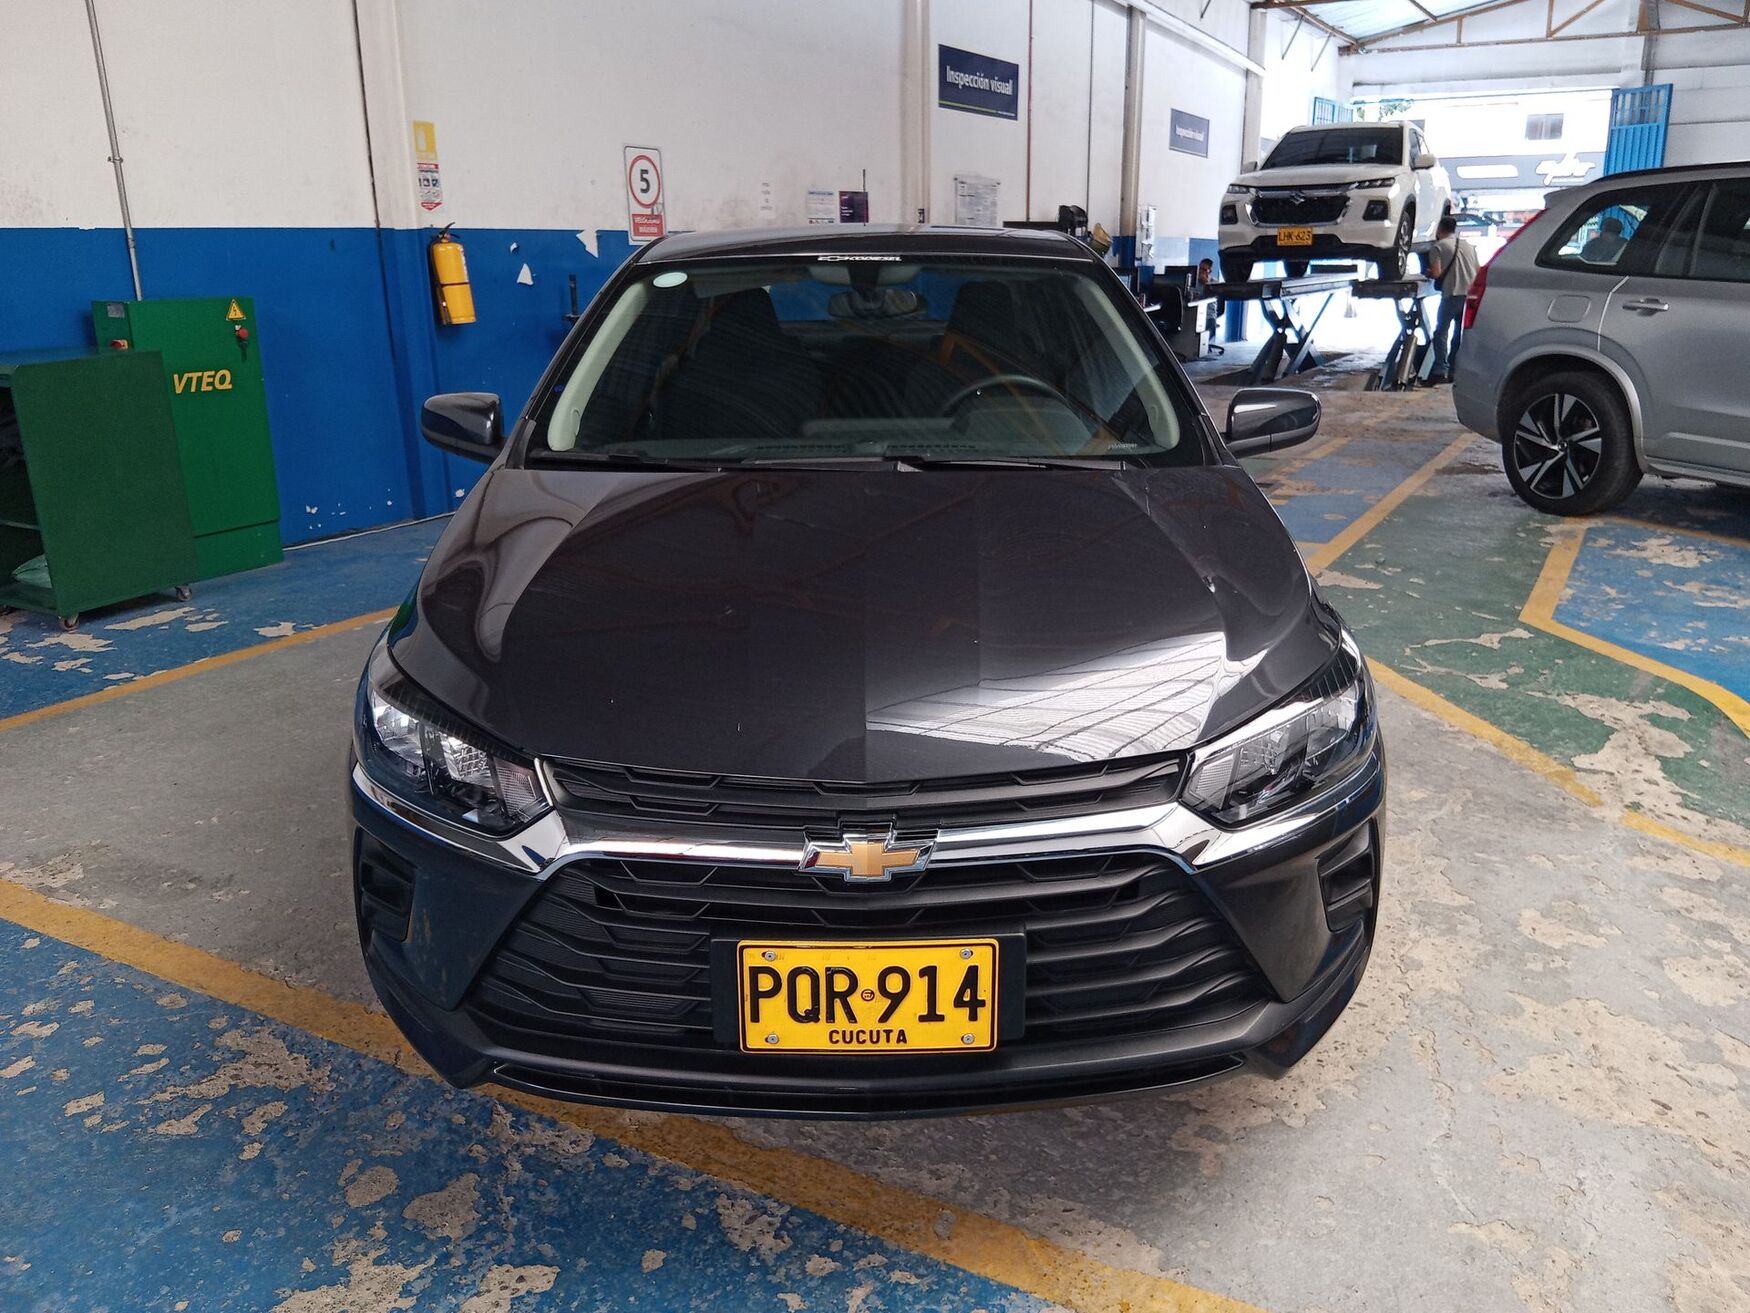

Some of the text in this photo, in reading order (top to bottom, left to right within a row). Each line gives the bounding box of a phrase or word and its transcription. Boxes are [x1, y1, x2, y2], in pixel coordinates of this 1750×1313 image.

[946, 65, 1013, 96] Inspección visual
[639, 168, 651, 194] 5
[173, 369, 233, 394] VTEQ
[748, 965, 986, 1024] PQR 914
[828, 1028, 908, 1045] CUCUTA
